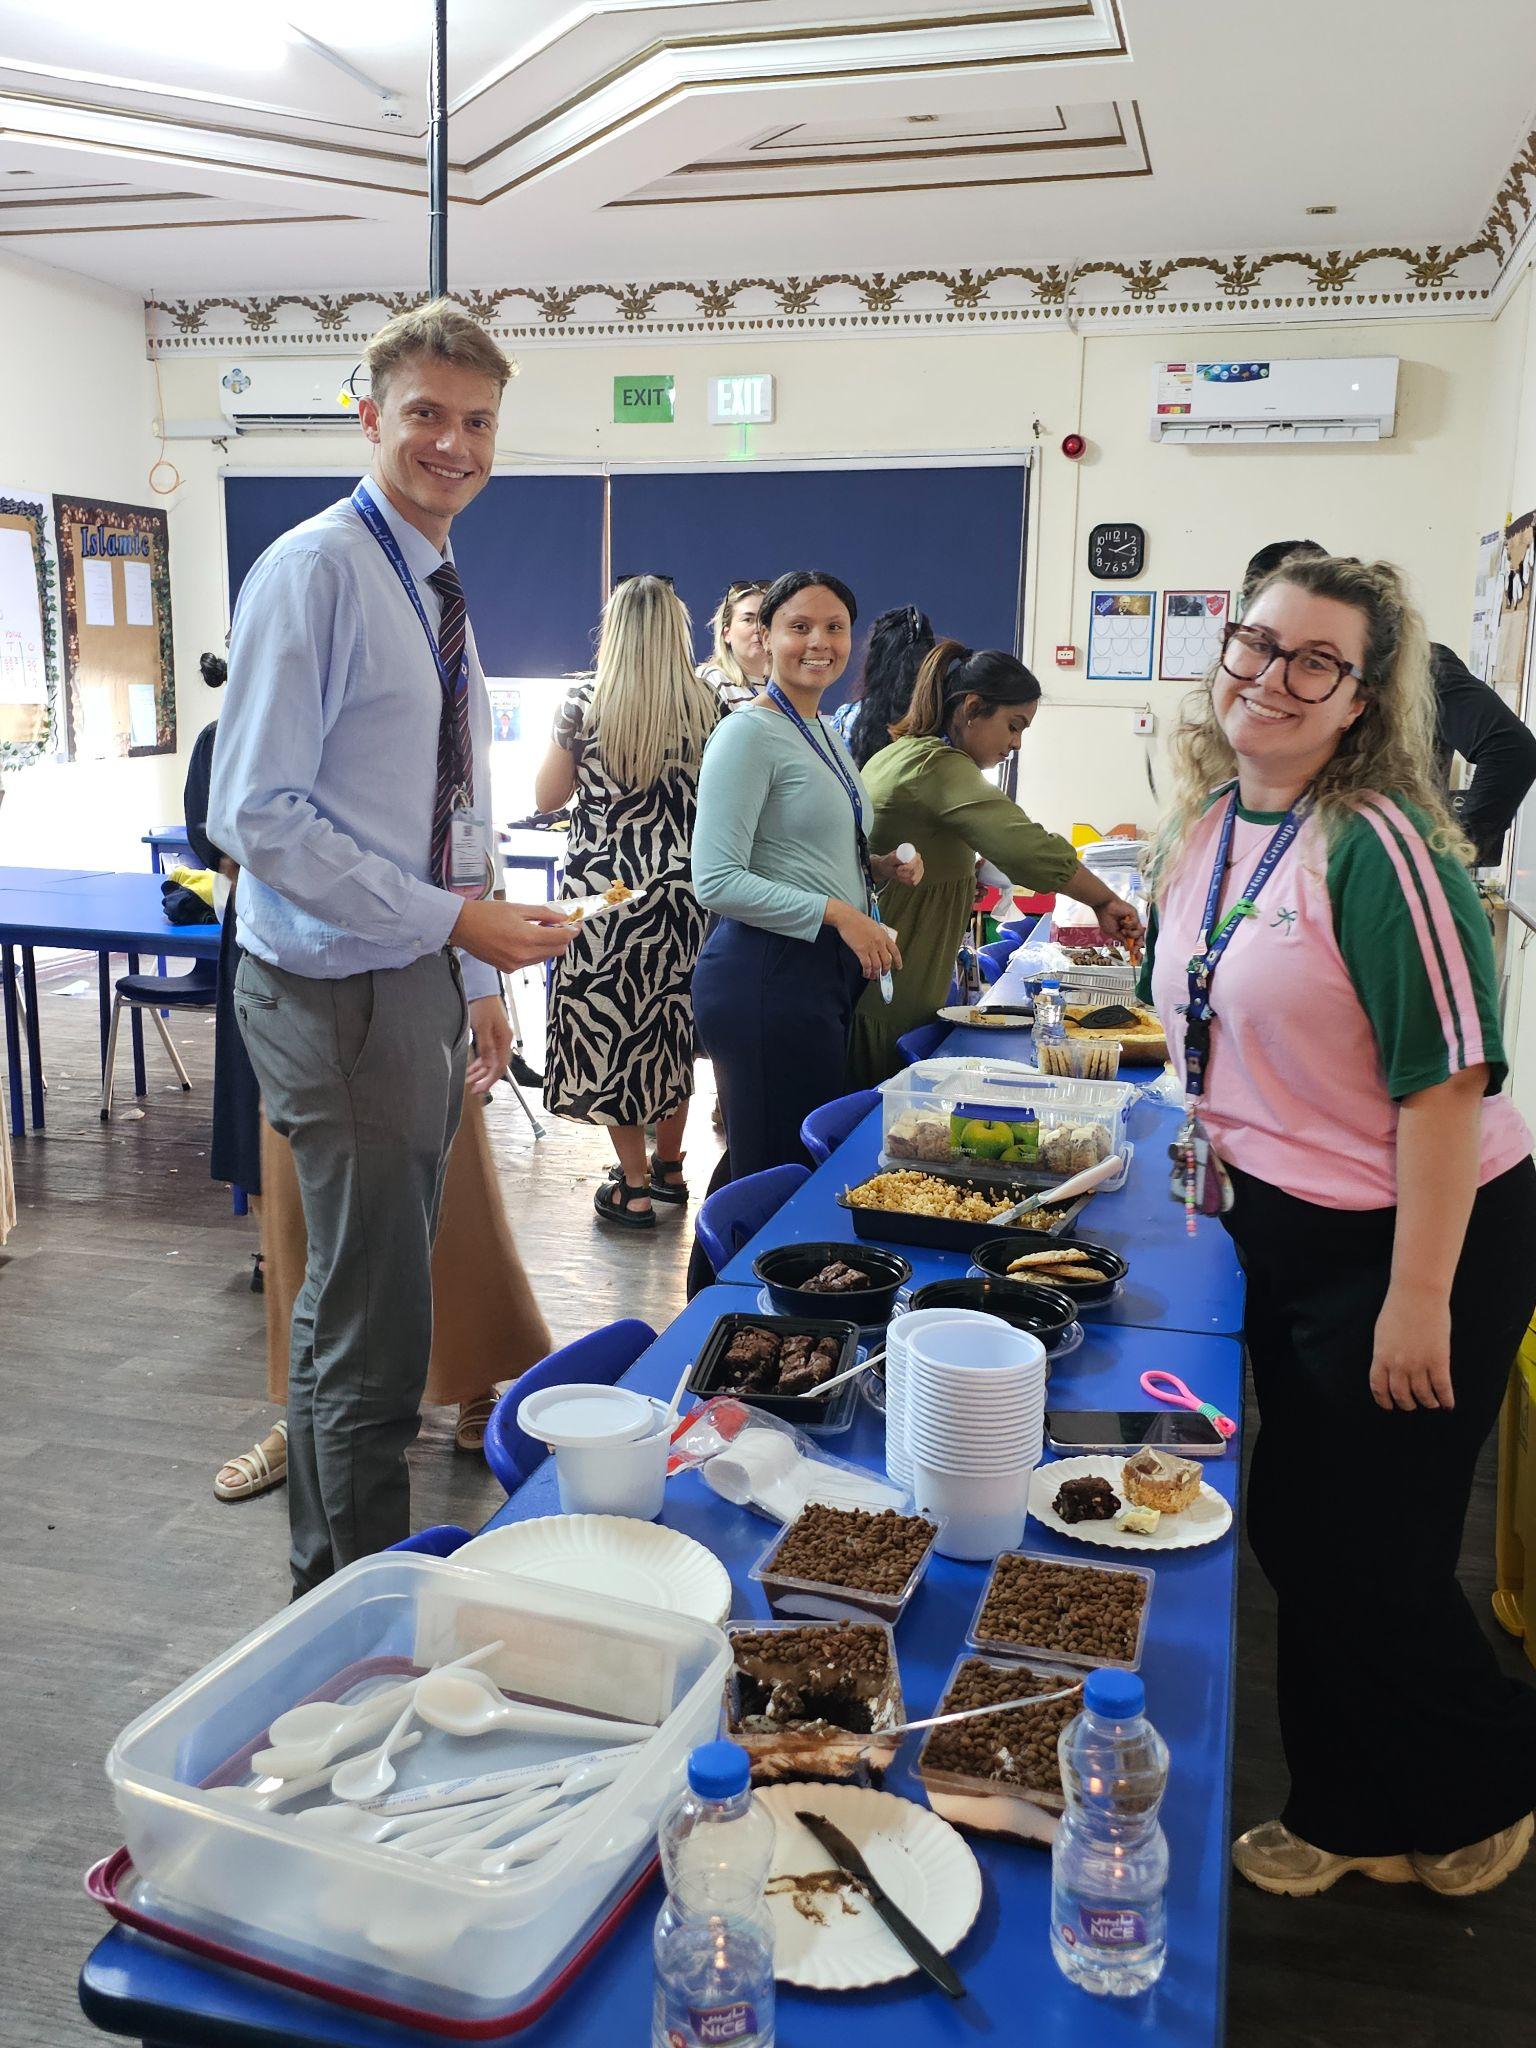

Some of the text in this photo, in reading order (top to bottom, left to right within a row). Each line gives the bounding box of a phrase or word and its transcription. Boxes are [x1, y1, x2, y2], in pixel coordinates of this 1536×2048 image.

[623, 388, 664, 406] EXIT
[717, 377, 763, 416] EXIT
[1105, 531, 1111, 541] 11
[1113, 530, 1120, 540] 12
[1124, 531, 1127, 540] 1
[1130, 535, 1136, 545] 2
[80, 525, 149, 557] Islamic
[1097, 536, 1105, 546] 10
[1096, 547, 1102, 557] 9
[1131, 546, 1137, 556] 3
[1096, 557, 1103, 567] 8
[1104, 562, 1110, 571] 7
[1129, 557, 1135, 566] 4
[1112, 563, 1118, 573] 6
[1121, 562, 1127, 572] 5
[1244, 868, 1268, 899] wton
[1263, 825, 1295, 863] Group
[1090, 1924, 1135, 1939] NICE
[701, 2018, 747, 2037] NICE
